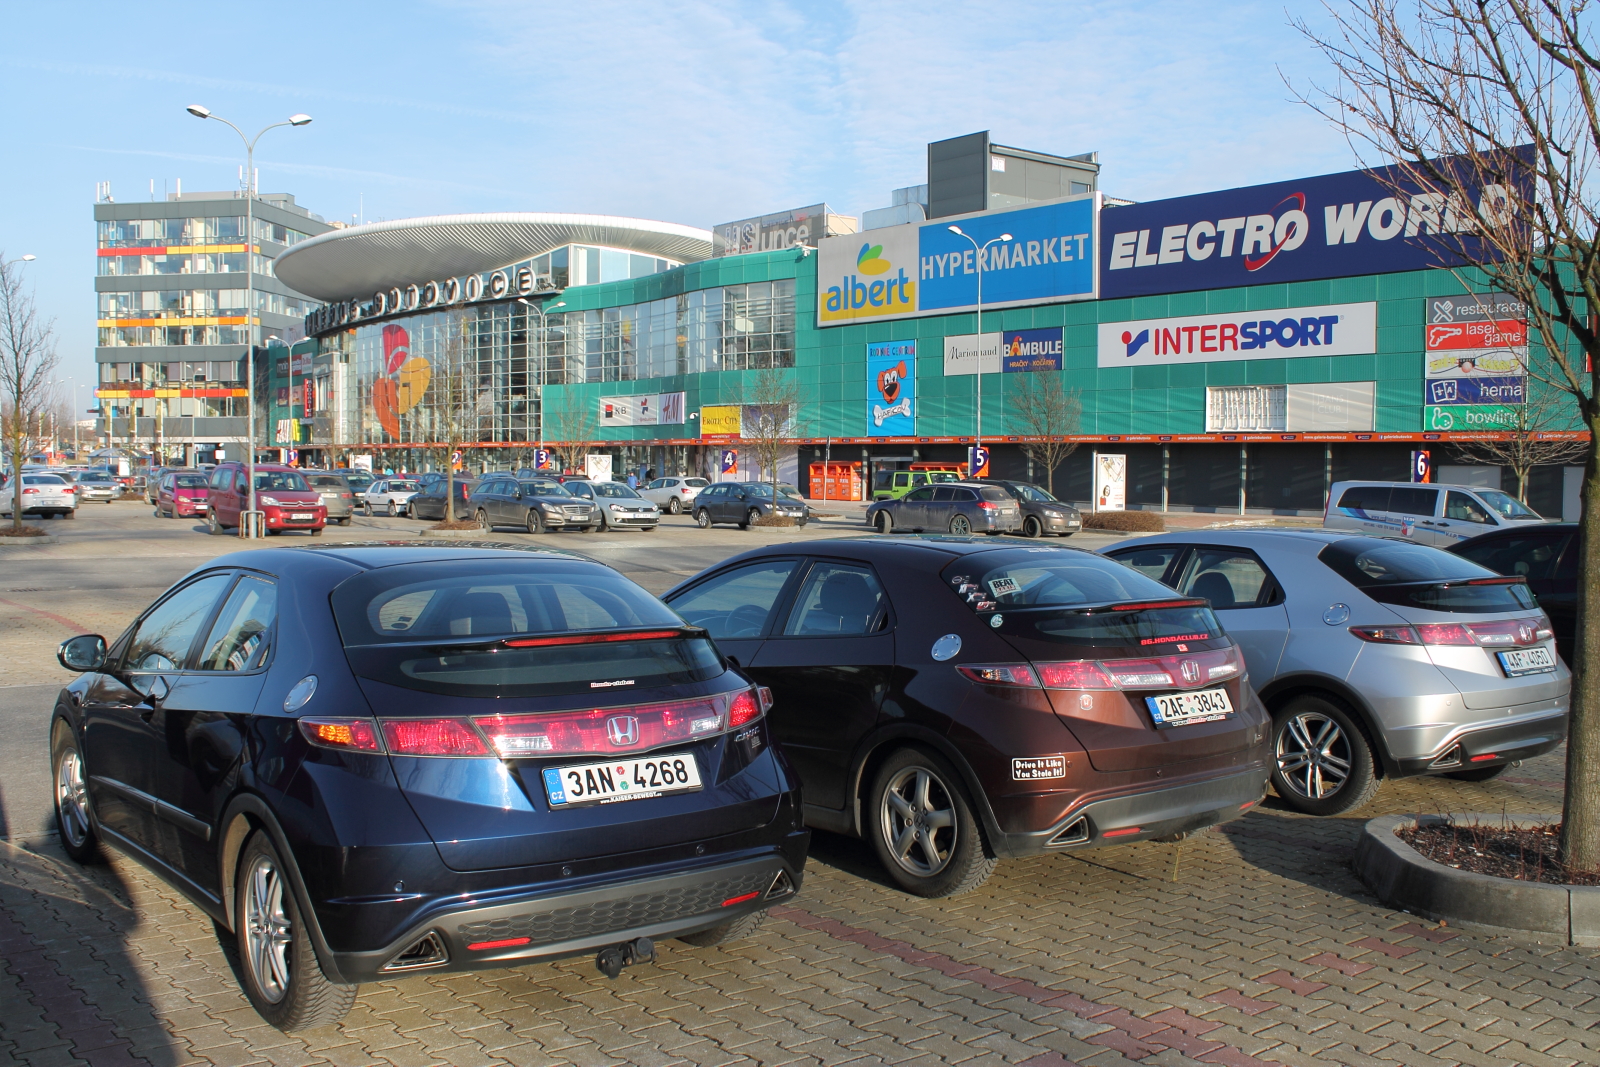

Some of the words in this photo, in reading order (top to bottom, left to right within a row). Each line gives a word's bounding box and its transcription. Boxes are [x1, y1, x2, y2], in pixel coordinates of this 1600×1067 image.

[1110, 209, 1309, 271] ELECTRO
[1324, 184, 1519, 247] WORLD
[921, 233, 1089, 281] HYPERMARKET
[826, 268, 910, 312] albert
[1456, 302, 1525, 316] restaurace
[1154, 316, 1339, 356] INTERSPORT
[1466, 323, 1495, 335] laser
[1484, 332, 1521, 346] game
[892, 345, 915, 356] CENTRUM
[1003, 340, 1062, 357] BAMBULE
[1480, 383, 1522, 397] herna
[615, 406, 627, 415] KB
[663, 394, 680, 423] H&M
[1318, 406, 1341, 414] CLUB
[289, 450, 295, 460] 1
[538, 451, 547, 464] 3
[724, 451, 733, 466] 4
[975, 449, 985, 467] 5
[1417, 454, 1426, 476] 6
[1527, 650, 1549, 666] 4050
[1160, 697, 1188, 718] 2AE
[1193, 692, 1226, 713] 3843
[1015, 760, 1036, 769] Drive
[1037, 760, 1044, 768] It
[1046, 759, 1062, 768] Like
[567, 766, 616, 797] 3AN
[633, 759, 689, 788] 4268
[1015, 769, 1030, 778] You
[1032, 769, 1052, 777] Stole
[1053, 767, 1063, 776] It!
[551, 791, 564, 800] CZ
